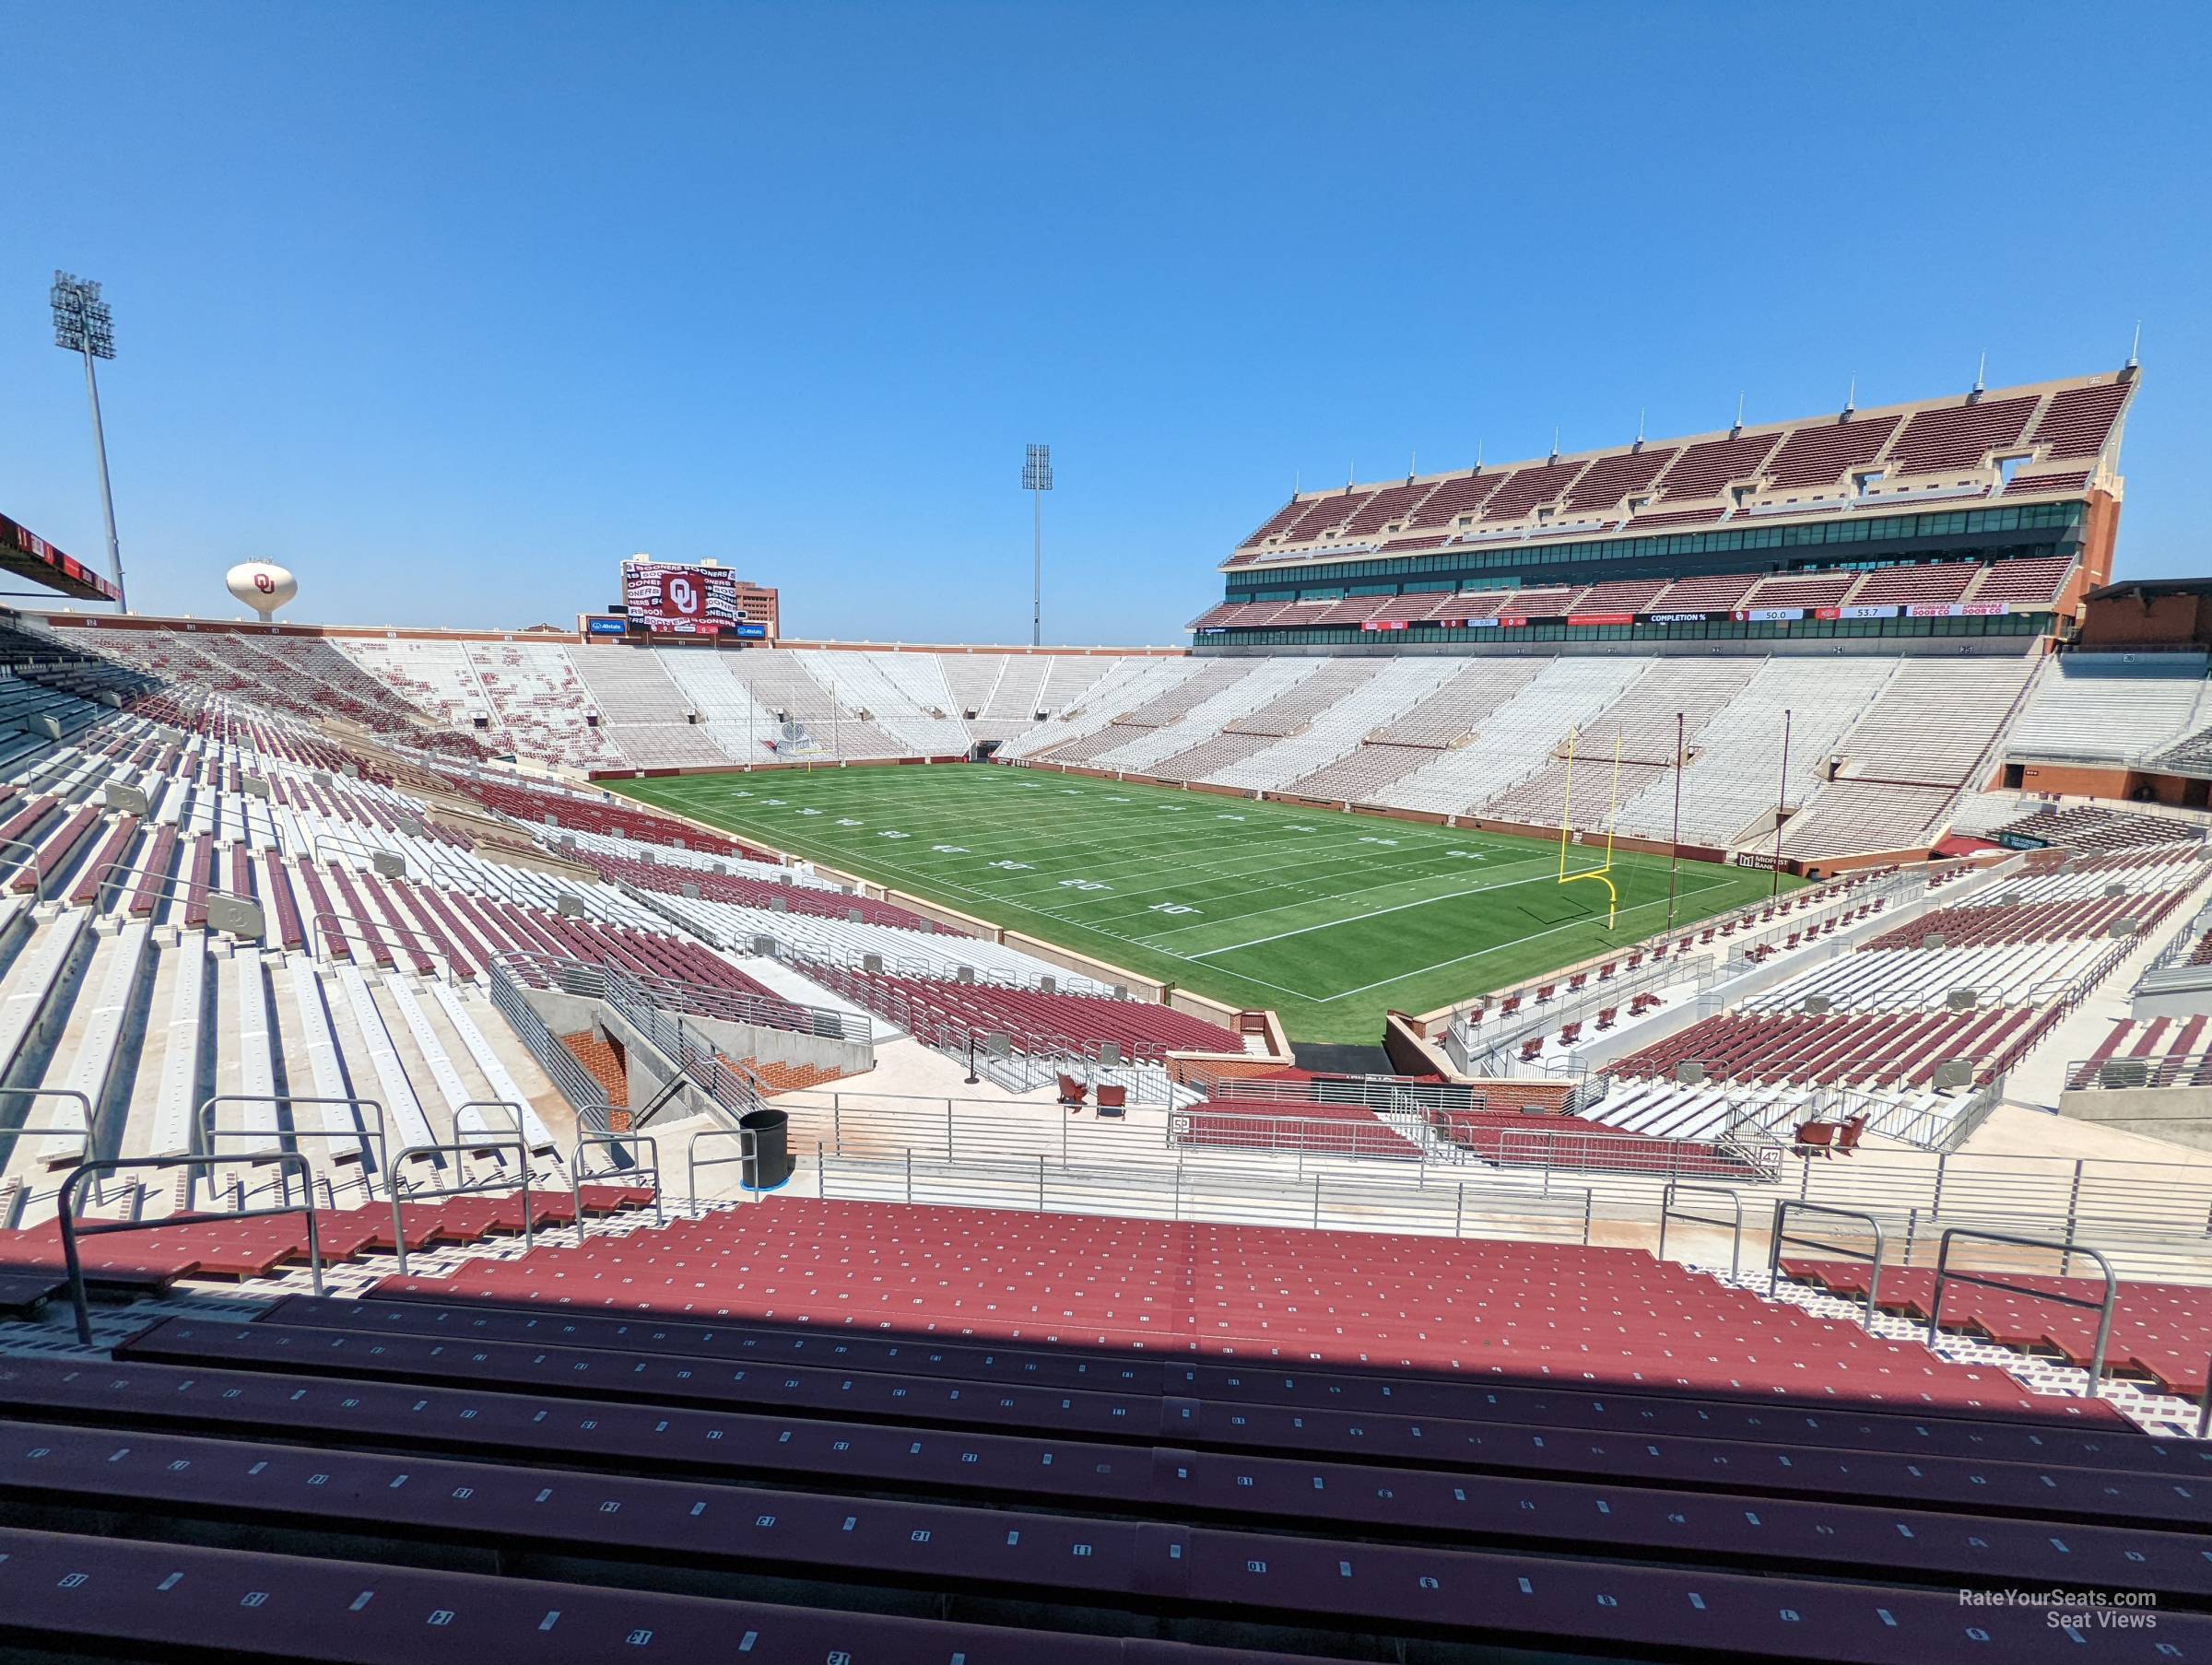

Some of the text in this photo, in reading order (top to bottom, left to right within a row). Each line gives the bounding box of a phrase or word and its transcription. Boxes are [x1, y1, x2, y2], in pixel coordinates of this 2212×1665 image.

[254, 573, 275, 594] OU
[670, 578, 697, 614] OU
[1651, 614, 1698, 622] COMPLETION
[1766, 611, 1786, 619] 50.0
[1857, 608, 1878, 616] 53.7
[1755, 862, 1775, 871] BANK
[1058, 878, 1106, 890] 20
[1147, 902, 1194, 914] 10
[1762, 1152, 1779, 1164] 47
[601, 1502, 619, 1512] 14
[757, 1516, 774, 1526] 13
[912, 1530, 929, 1542] 12
[1075, 1544, 1090, 1555] 11
[1249, 1561, 1265, 1572] 10
[58, 1574, 88, 1587] 16
[241, 1592, 267, 1606] 15
[428, 1610, 453, 1624] 14
[627, 1630, 652, 1645] 13
